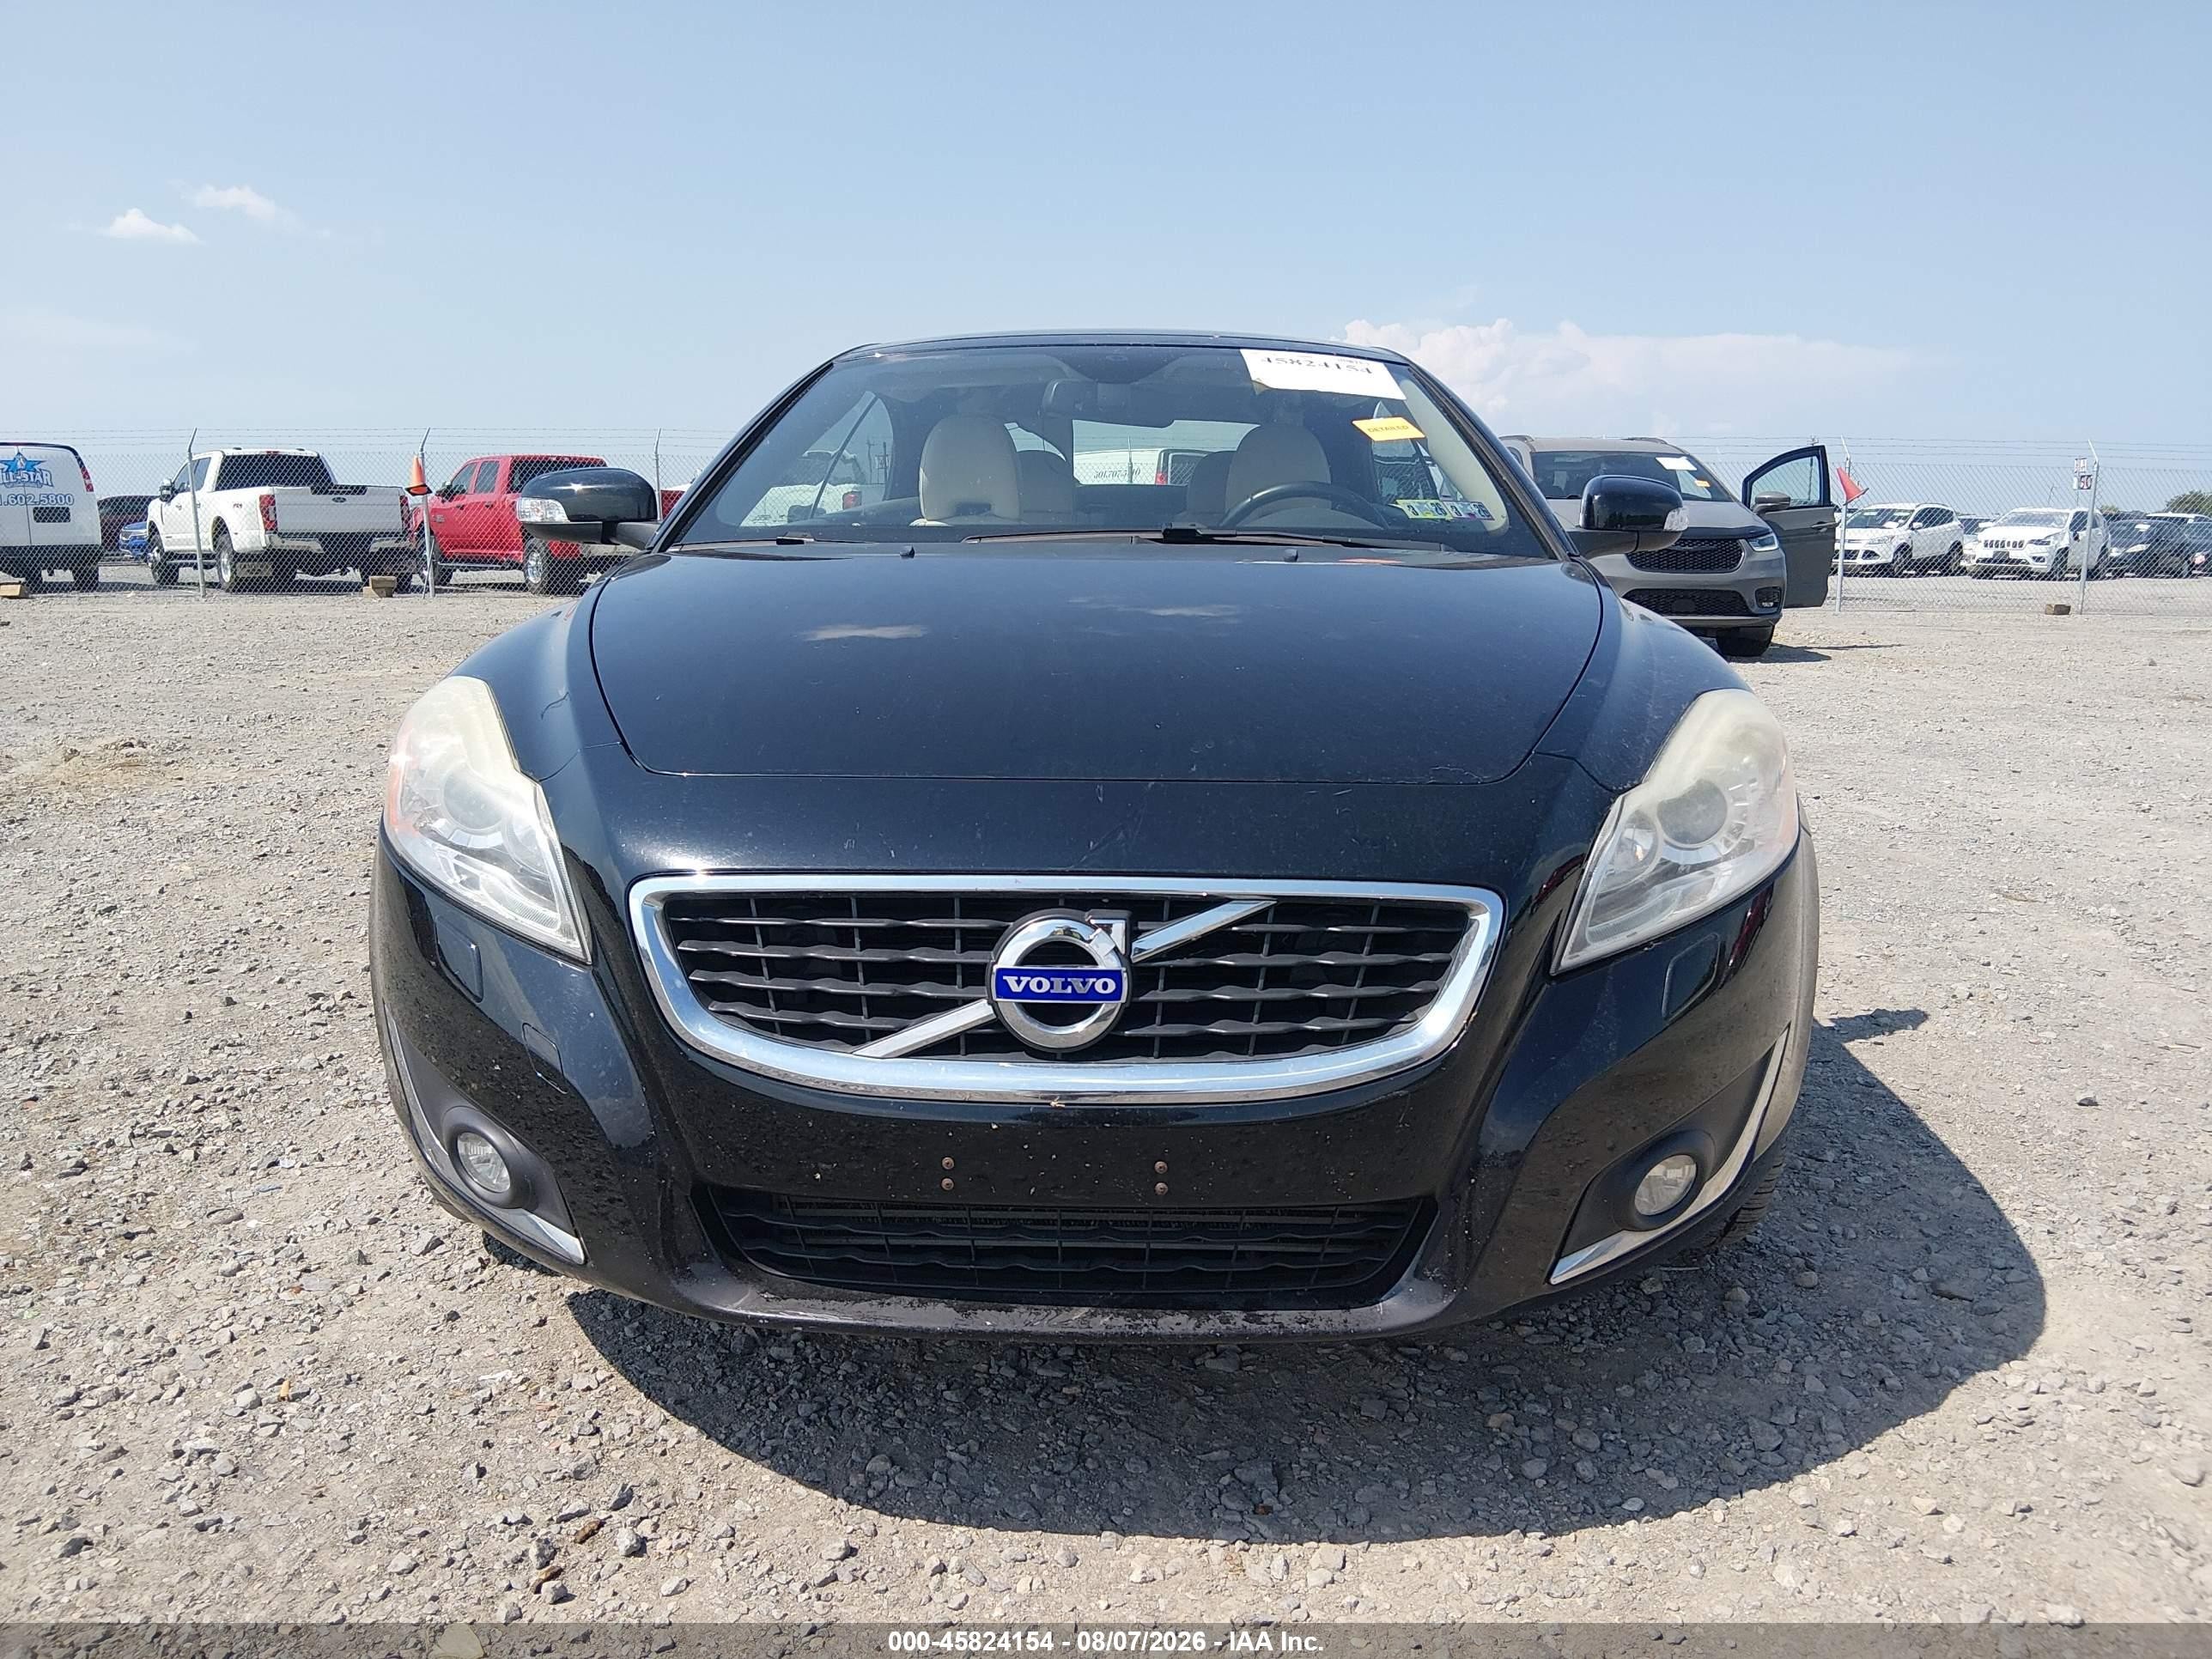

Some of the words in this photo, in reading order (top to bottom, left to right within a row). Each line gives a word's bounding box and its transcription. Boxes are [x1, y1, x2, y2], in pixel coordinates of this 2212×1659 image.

[1261, 356, 1373, 374] 45824154
[1366, 424, 1409, 433] DETAILED
[1407, 504, 1419, 516] 3
[1430, 501, 1448, 517] 26
[1449, 505, 1463, 517] 3
[1002, 975, 1116, 995] VOLVO
